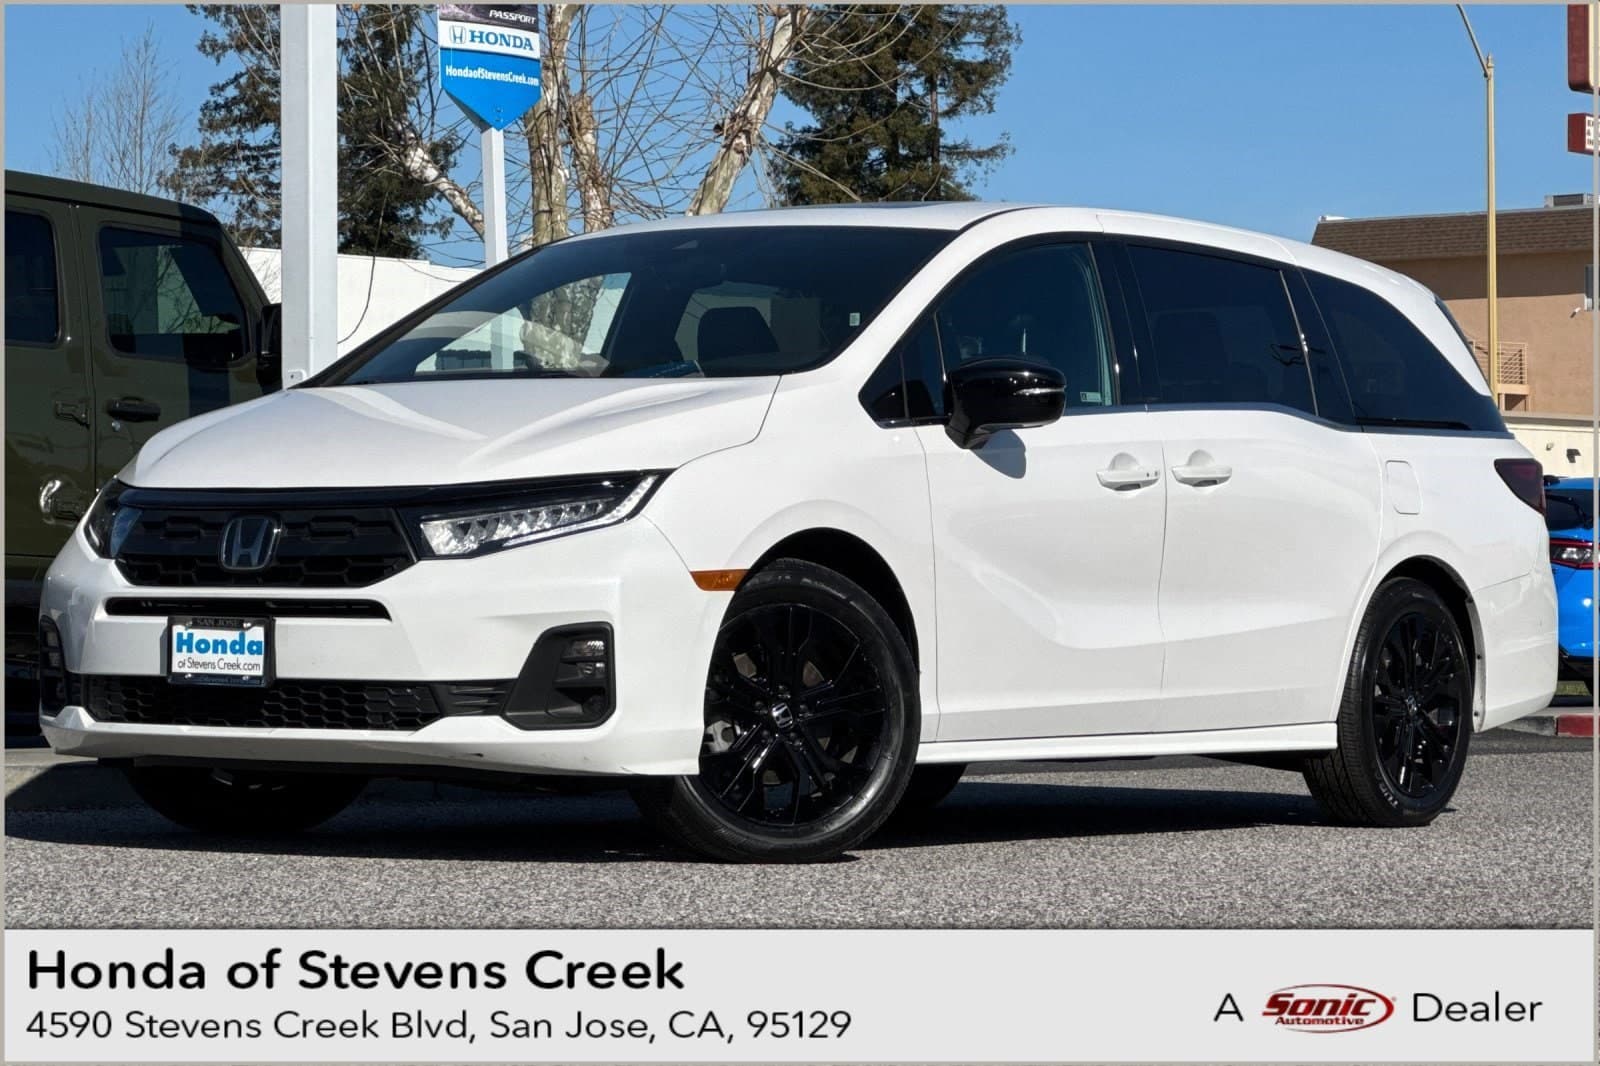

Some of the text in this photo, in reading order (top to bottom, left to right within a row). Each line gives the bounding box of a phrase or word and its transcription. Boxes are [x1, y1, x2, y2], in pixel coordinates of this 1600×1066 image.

[489, 9, 536, 25] PASSPORT
[469, 29, 534, 51] HONDA
[445, 64, 539, 87] HondaofStevensCreek.com
[176, 631, 263, 656] Honda
[177, 657, 261, 672] of Stevens Creek.com
